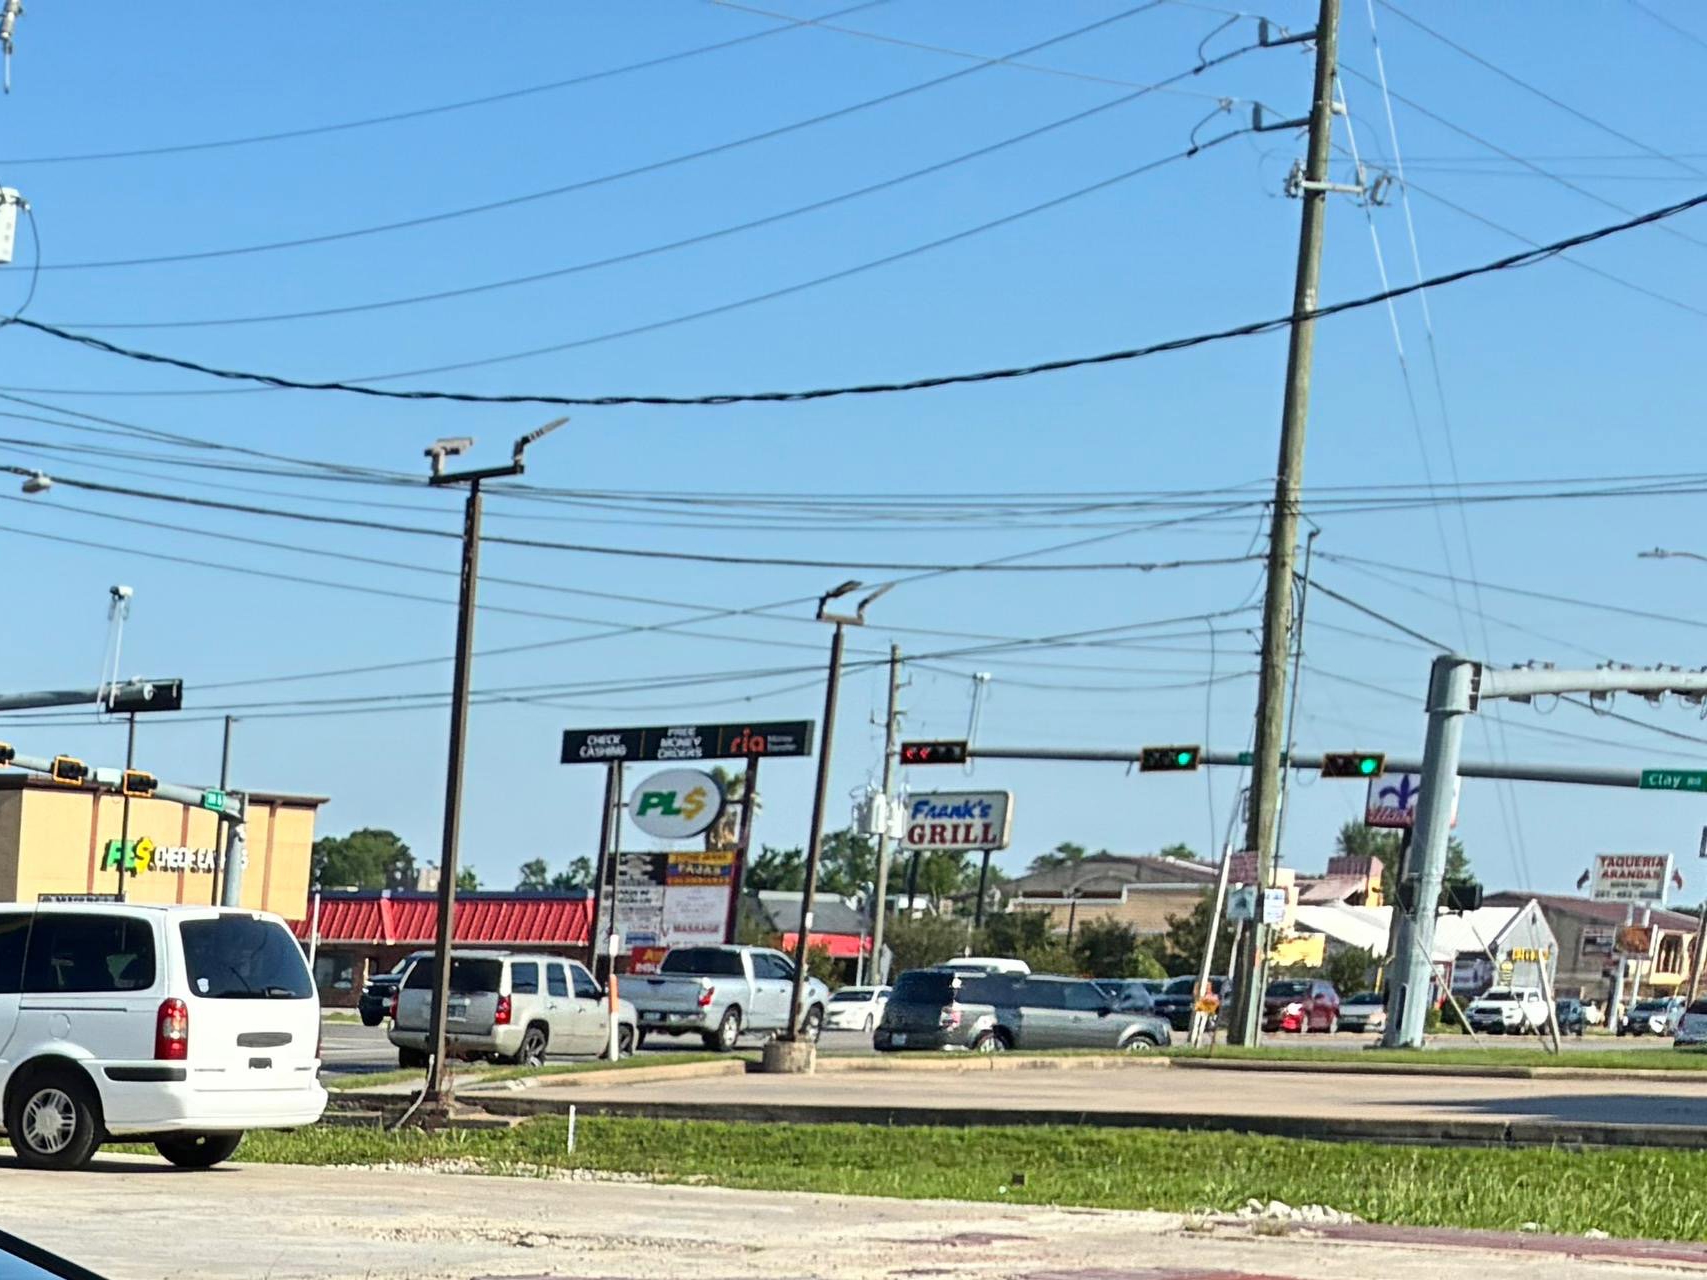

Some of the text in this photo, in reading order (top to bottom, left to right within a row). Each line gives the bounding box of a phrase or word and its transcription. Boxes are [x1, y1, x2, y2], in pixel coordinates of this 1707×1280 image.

[729, 727, 765, 755] ria
[1648, 773, 1683, 789] Clay
[911, 800, 993, 821] Frank's
[906, 823, 997, 846] GRILL
[1599, 855, 1666, 868] TAQUERIA
